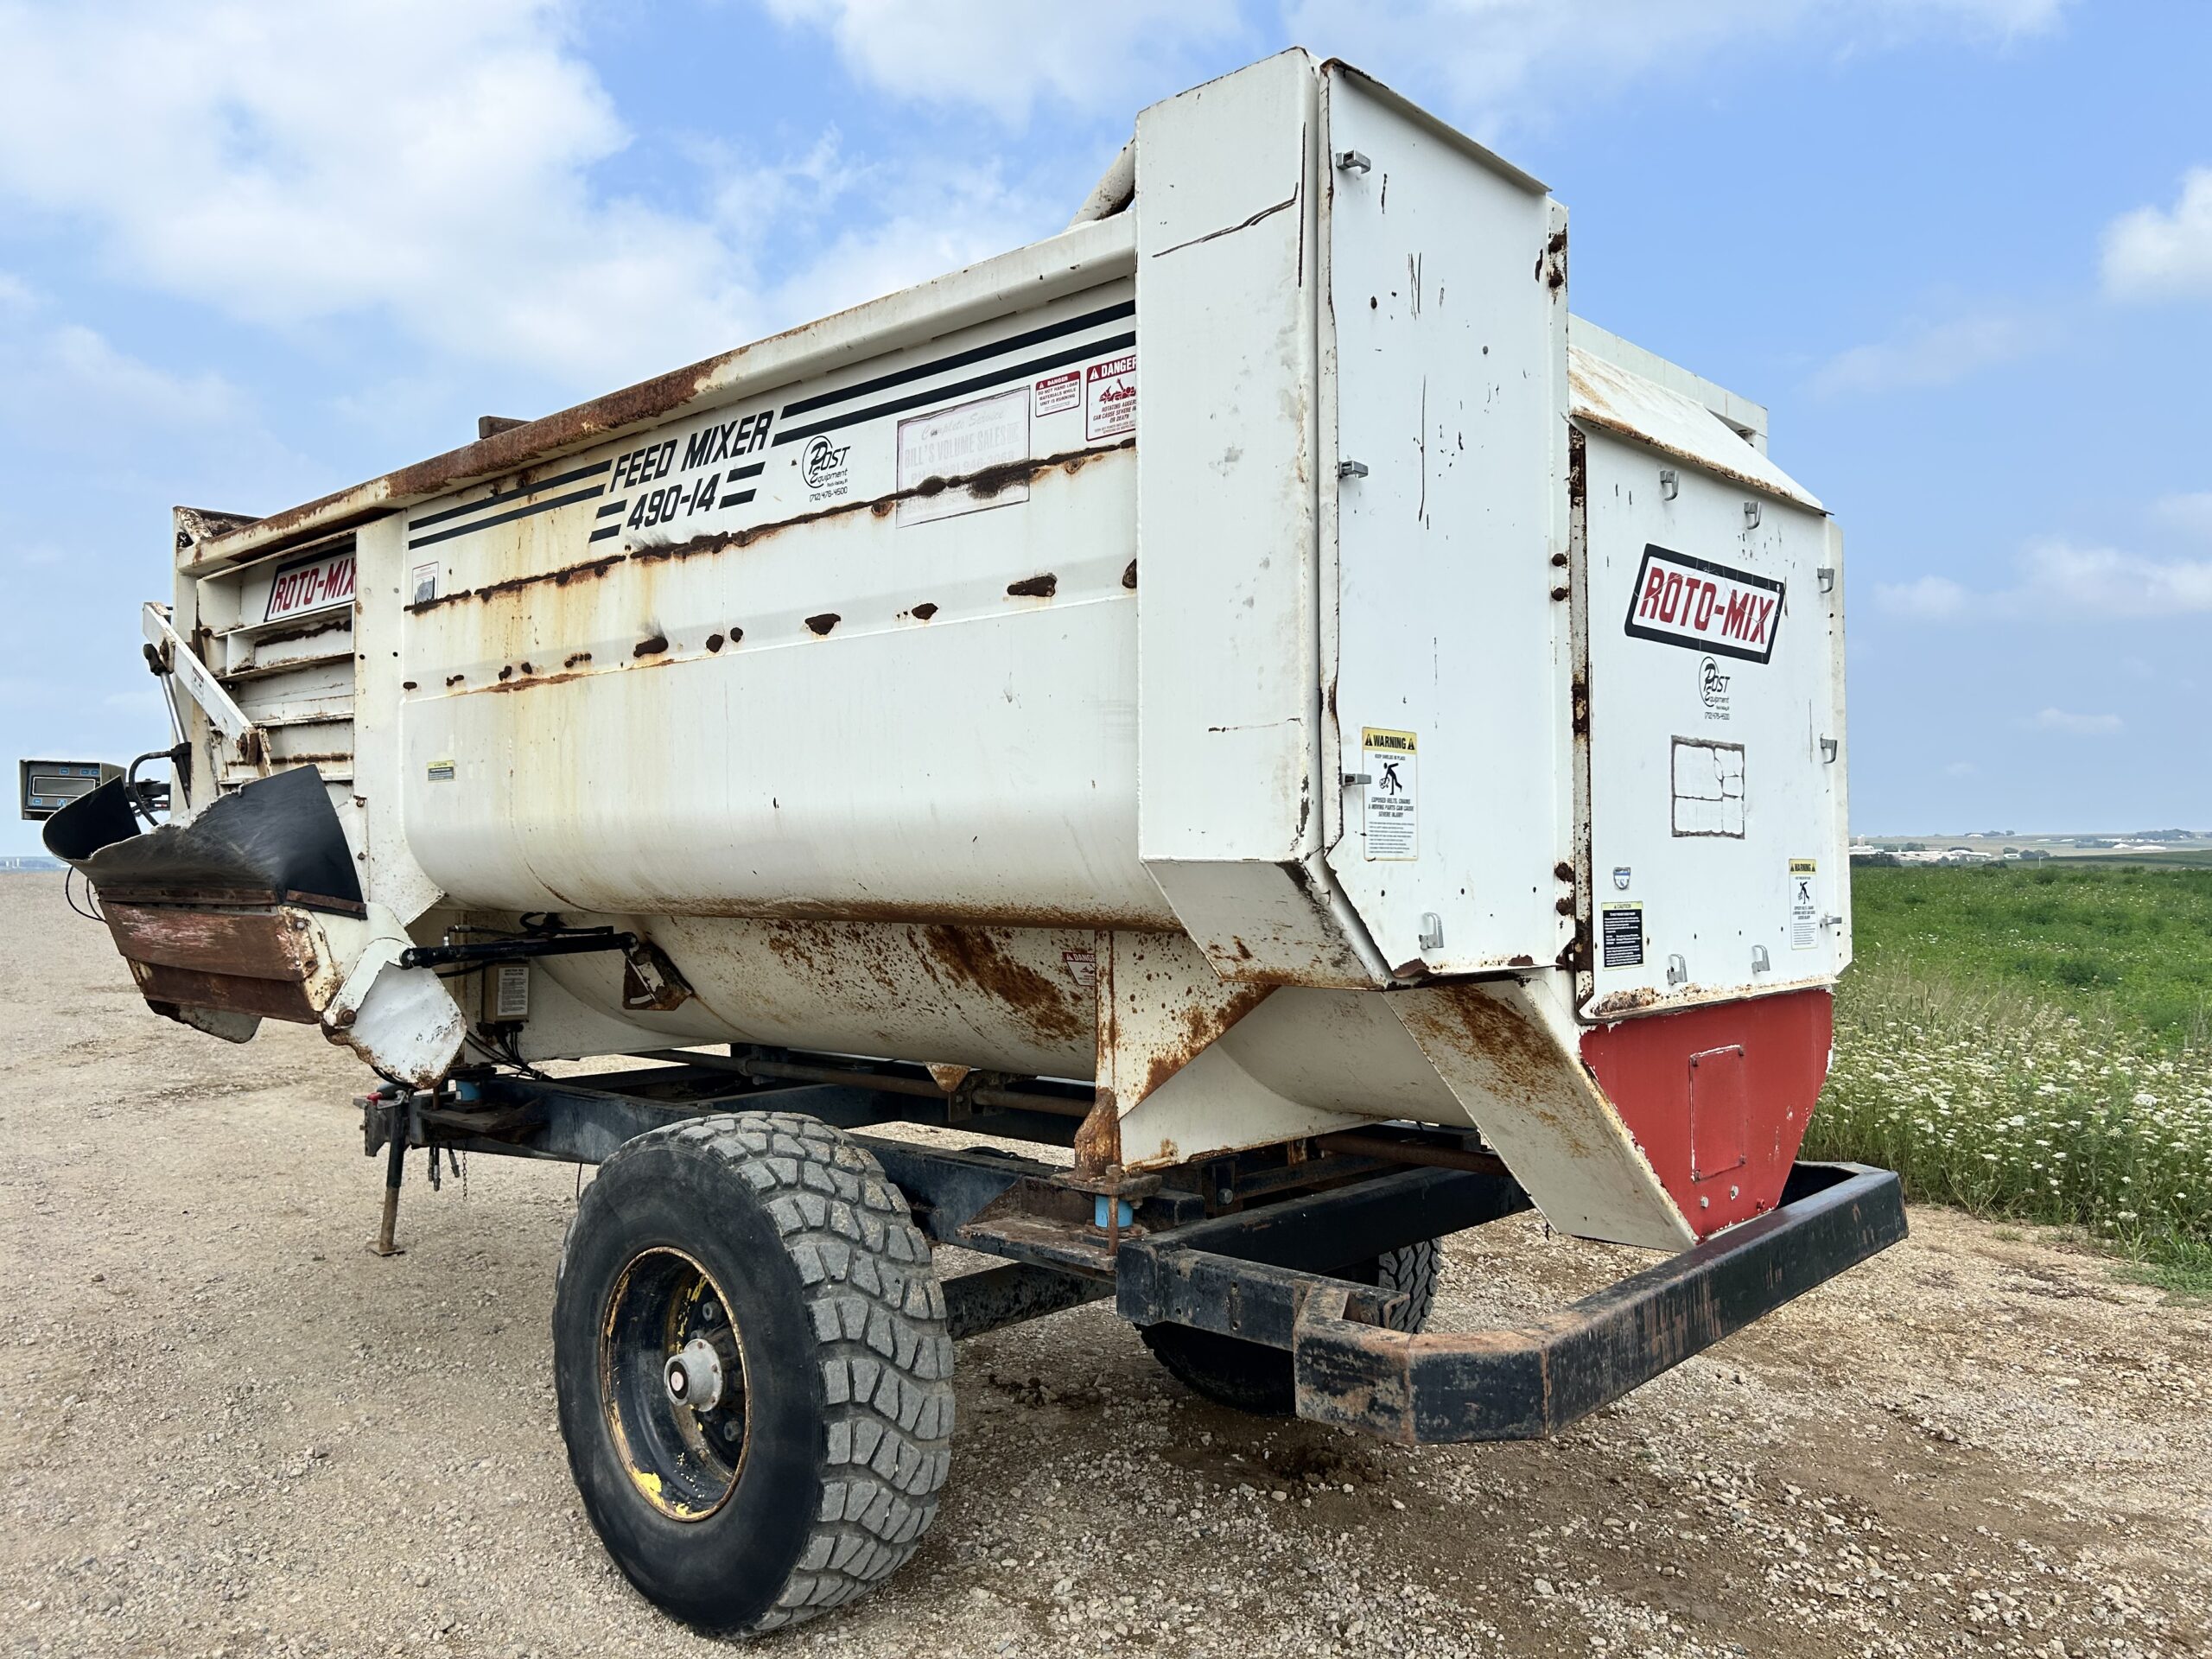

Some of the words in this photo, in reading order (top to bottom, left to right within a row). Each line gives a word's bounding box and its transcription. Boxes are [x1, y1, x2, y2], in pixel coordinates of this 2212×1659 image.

[1046, 376, 1069, 386] DANGER
[1039, 391, 1062, 401] MATERIALS
[1055, 393, 1076, 402] RUNNING
[1102, 403, 1121, 412] ROTATING
[1102, 410, 1115, 419] CAUSE
[1116, 406, 1131, 415] SEVERE
[609, 438, 678, 493] FEED
[680, 410, 774, 472] MIXER
[905, 443, 934, 468] BILL'S
[938, 433, 975, 461] VOLUME
[977, 424, 1006, 451] SALES
[810, 466, 849, 485] Equipment
[821, 486, 849, 499] 476-4500
[626, 473, 721, 531] 490-14
[271, 556, 357, 613] ROTO-MIX
[1638, 566, 1775, 645] ROTO-MIX
[1373, 734, 1407, 749] WARNING
[1072, 953, 1096, 962] DANGE
